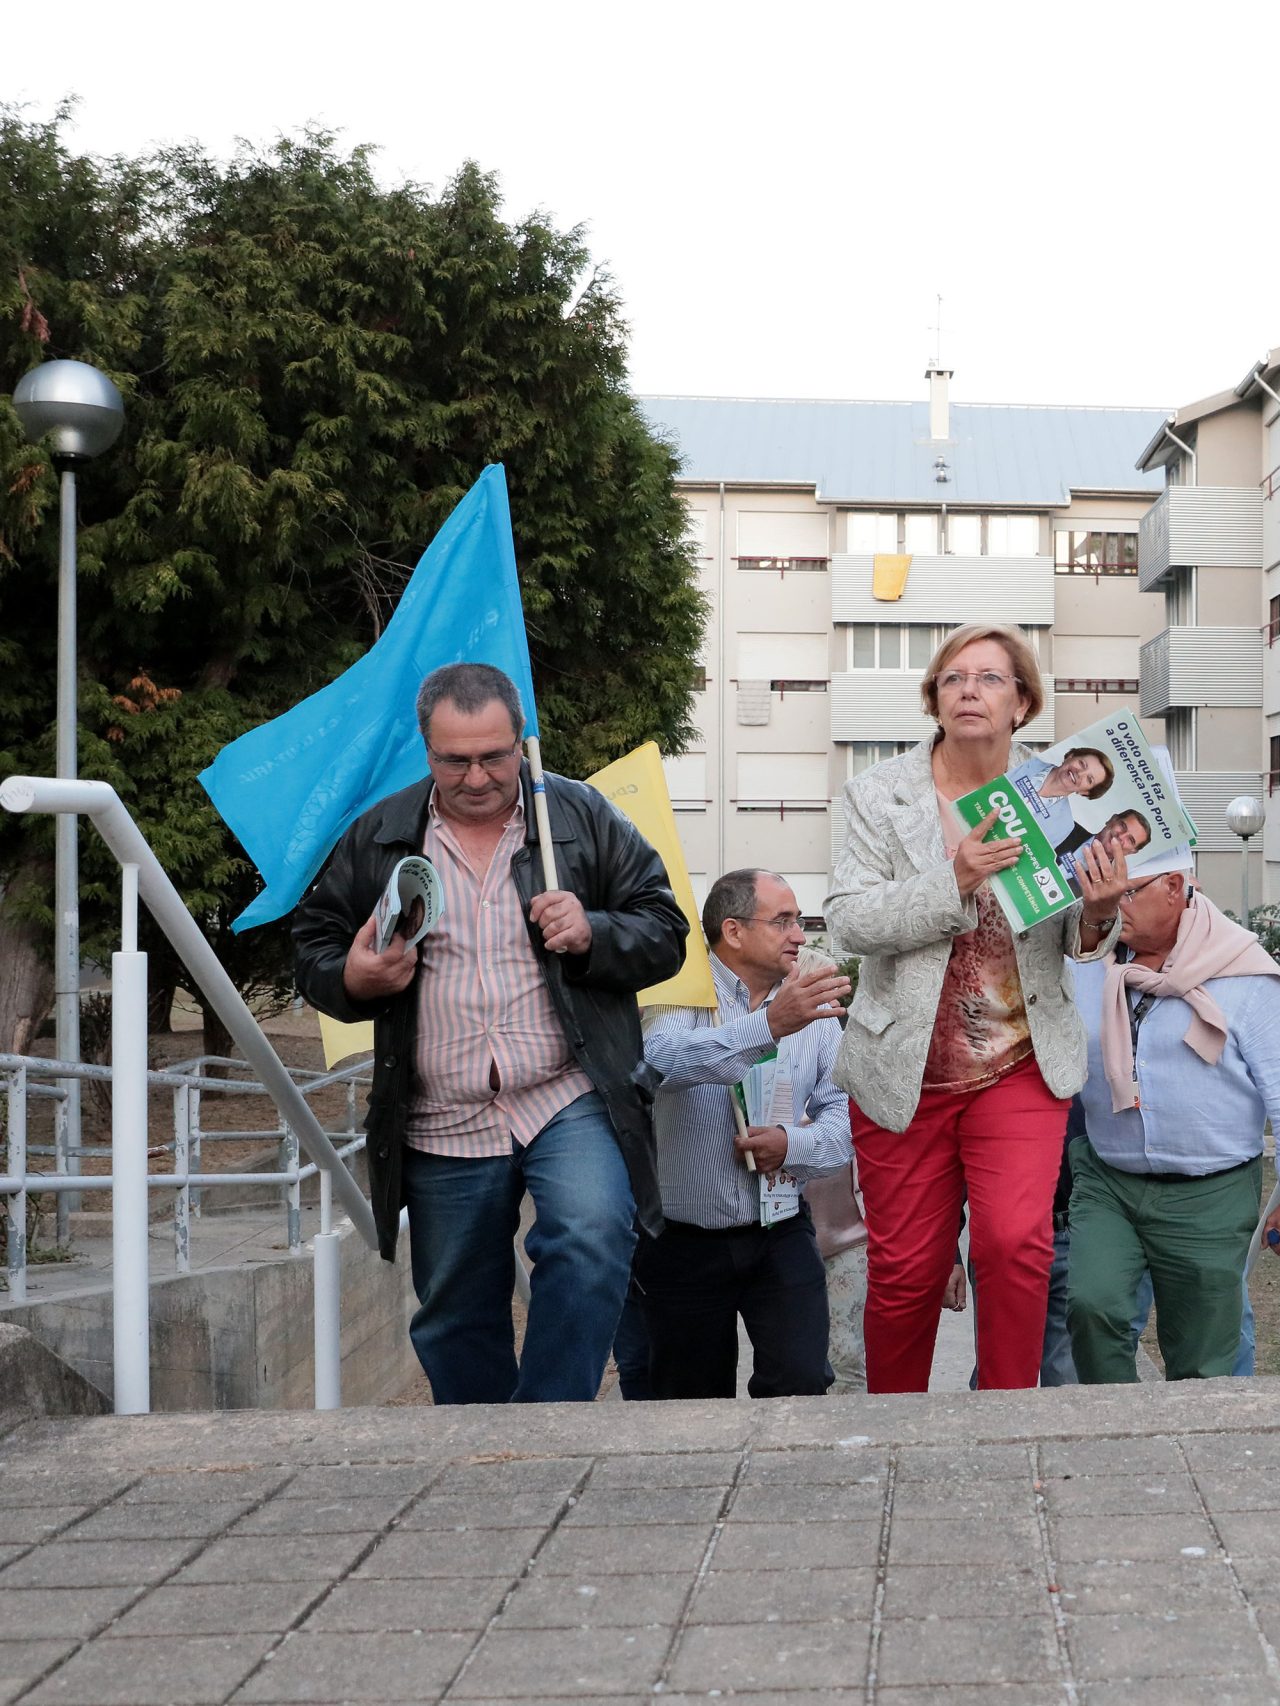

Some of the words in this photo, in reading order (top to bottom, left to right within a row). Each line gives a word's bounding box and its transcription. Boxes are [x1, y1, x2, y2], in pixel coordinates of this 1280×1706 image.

[1105, 728, 1115, 736] a
[1111, 737, 1145, 790] diferença
[1141, 791, 1154, 806] no
[1150, 806, 1172, 839] Porto
[1117, 722, 1128, 731] O
[1123, 732, 1141, 758] voto
[1138, 759, 1155, 781] que
[1151, 782, 1166, 801] faz
[988, 790, 1028, 838] CDU
[1022, 843, 1041, 870] PCP-PEV
[1016, 875, 1040, 914] COMPETÊNCIA
